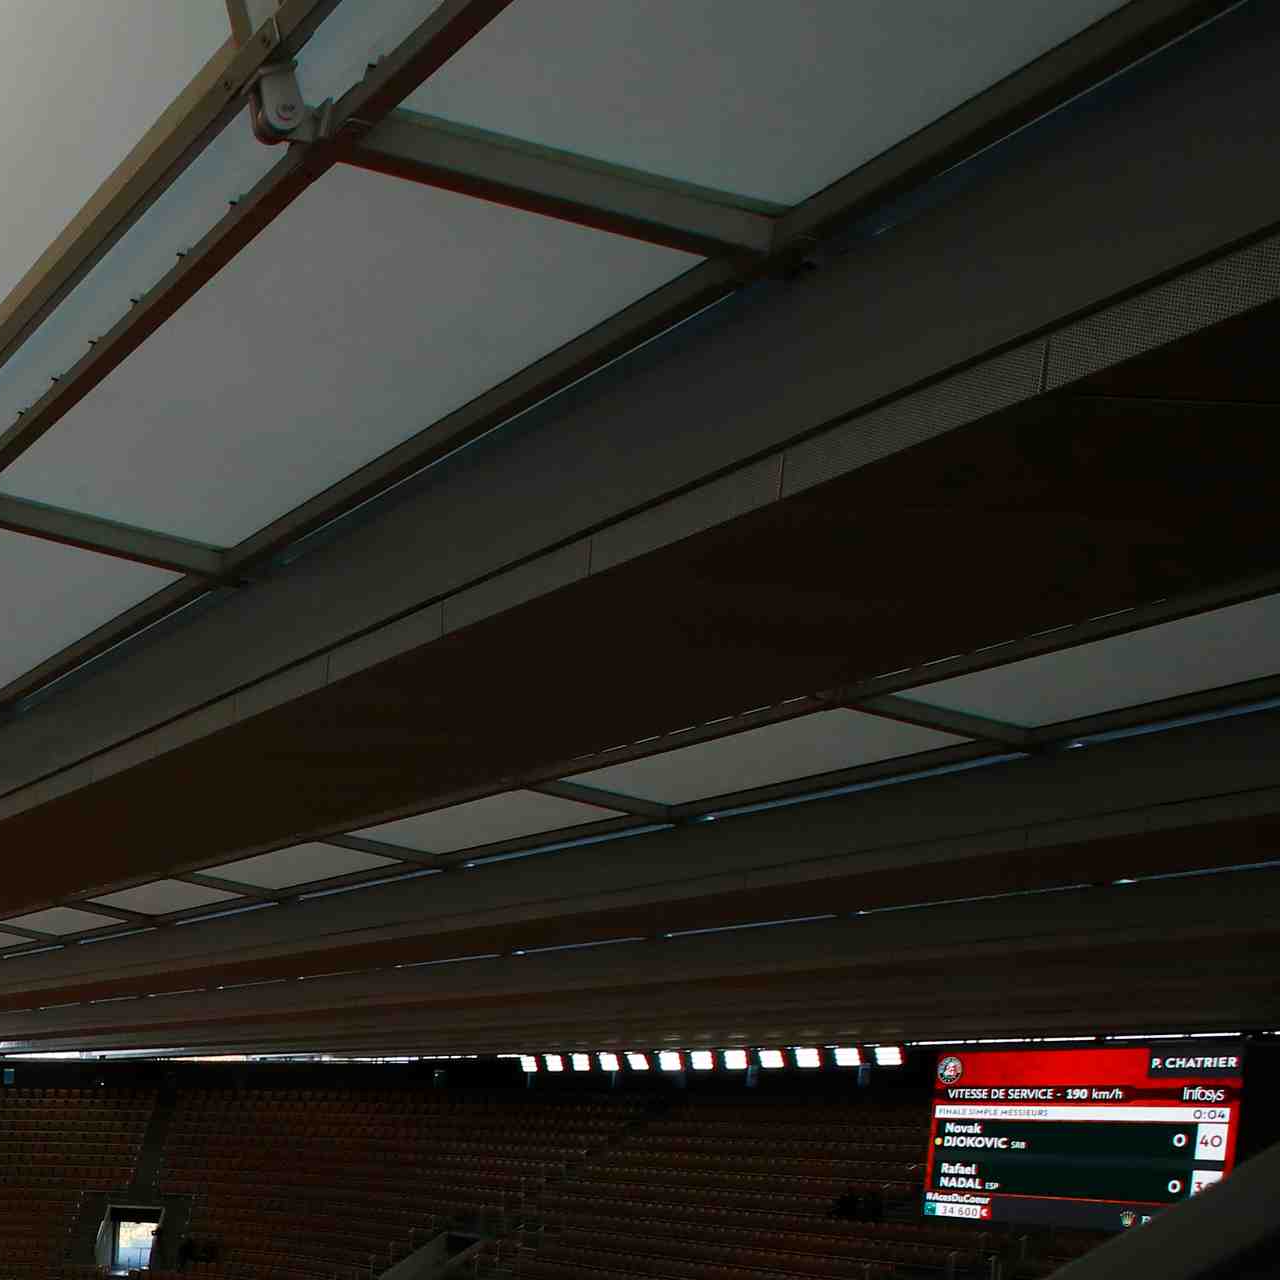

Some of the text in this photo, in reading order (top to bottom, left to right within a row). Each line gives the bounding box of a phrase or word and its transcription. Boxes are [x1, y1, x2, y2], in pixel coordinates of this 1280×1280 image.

[1151, 1057, 1237, 1068] P. CHATRIER
[948, 1089, 989, 1099] VITESSE
[991, 1089, 1006, 1099] DE
[1008, 1089, 1053, 1099] SERVICE
[1065, 1089, 1088, 1099] 190
[1092, 1088, 1123, 1099] km/h
[1183, 1087, 1225, 1103] Infosys
[1193, 1110, 1226, 1120] 0:04
[945, 1122, 982, 1133] Novak
[944, 1136, 1026, 1149] DJOKOVIC SRB
[1173, 1133, 1186, 1147] 0
[1199, 1135, 1222, 1147] 40
[941, 1163, 976, 1174] Rafael
[940, 1176, 982, 1189] NADAL
[1167, 1179, 1181, 1193] 0
[926, 1192, 991, 1204] #AcesDuCoeur
